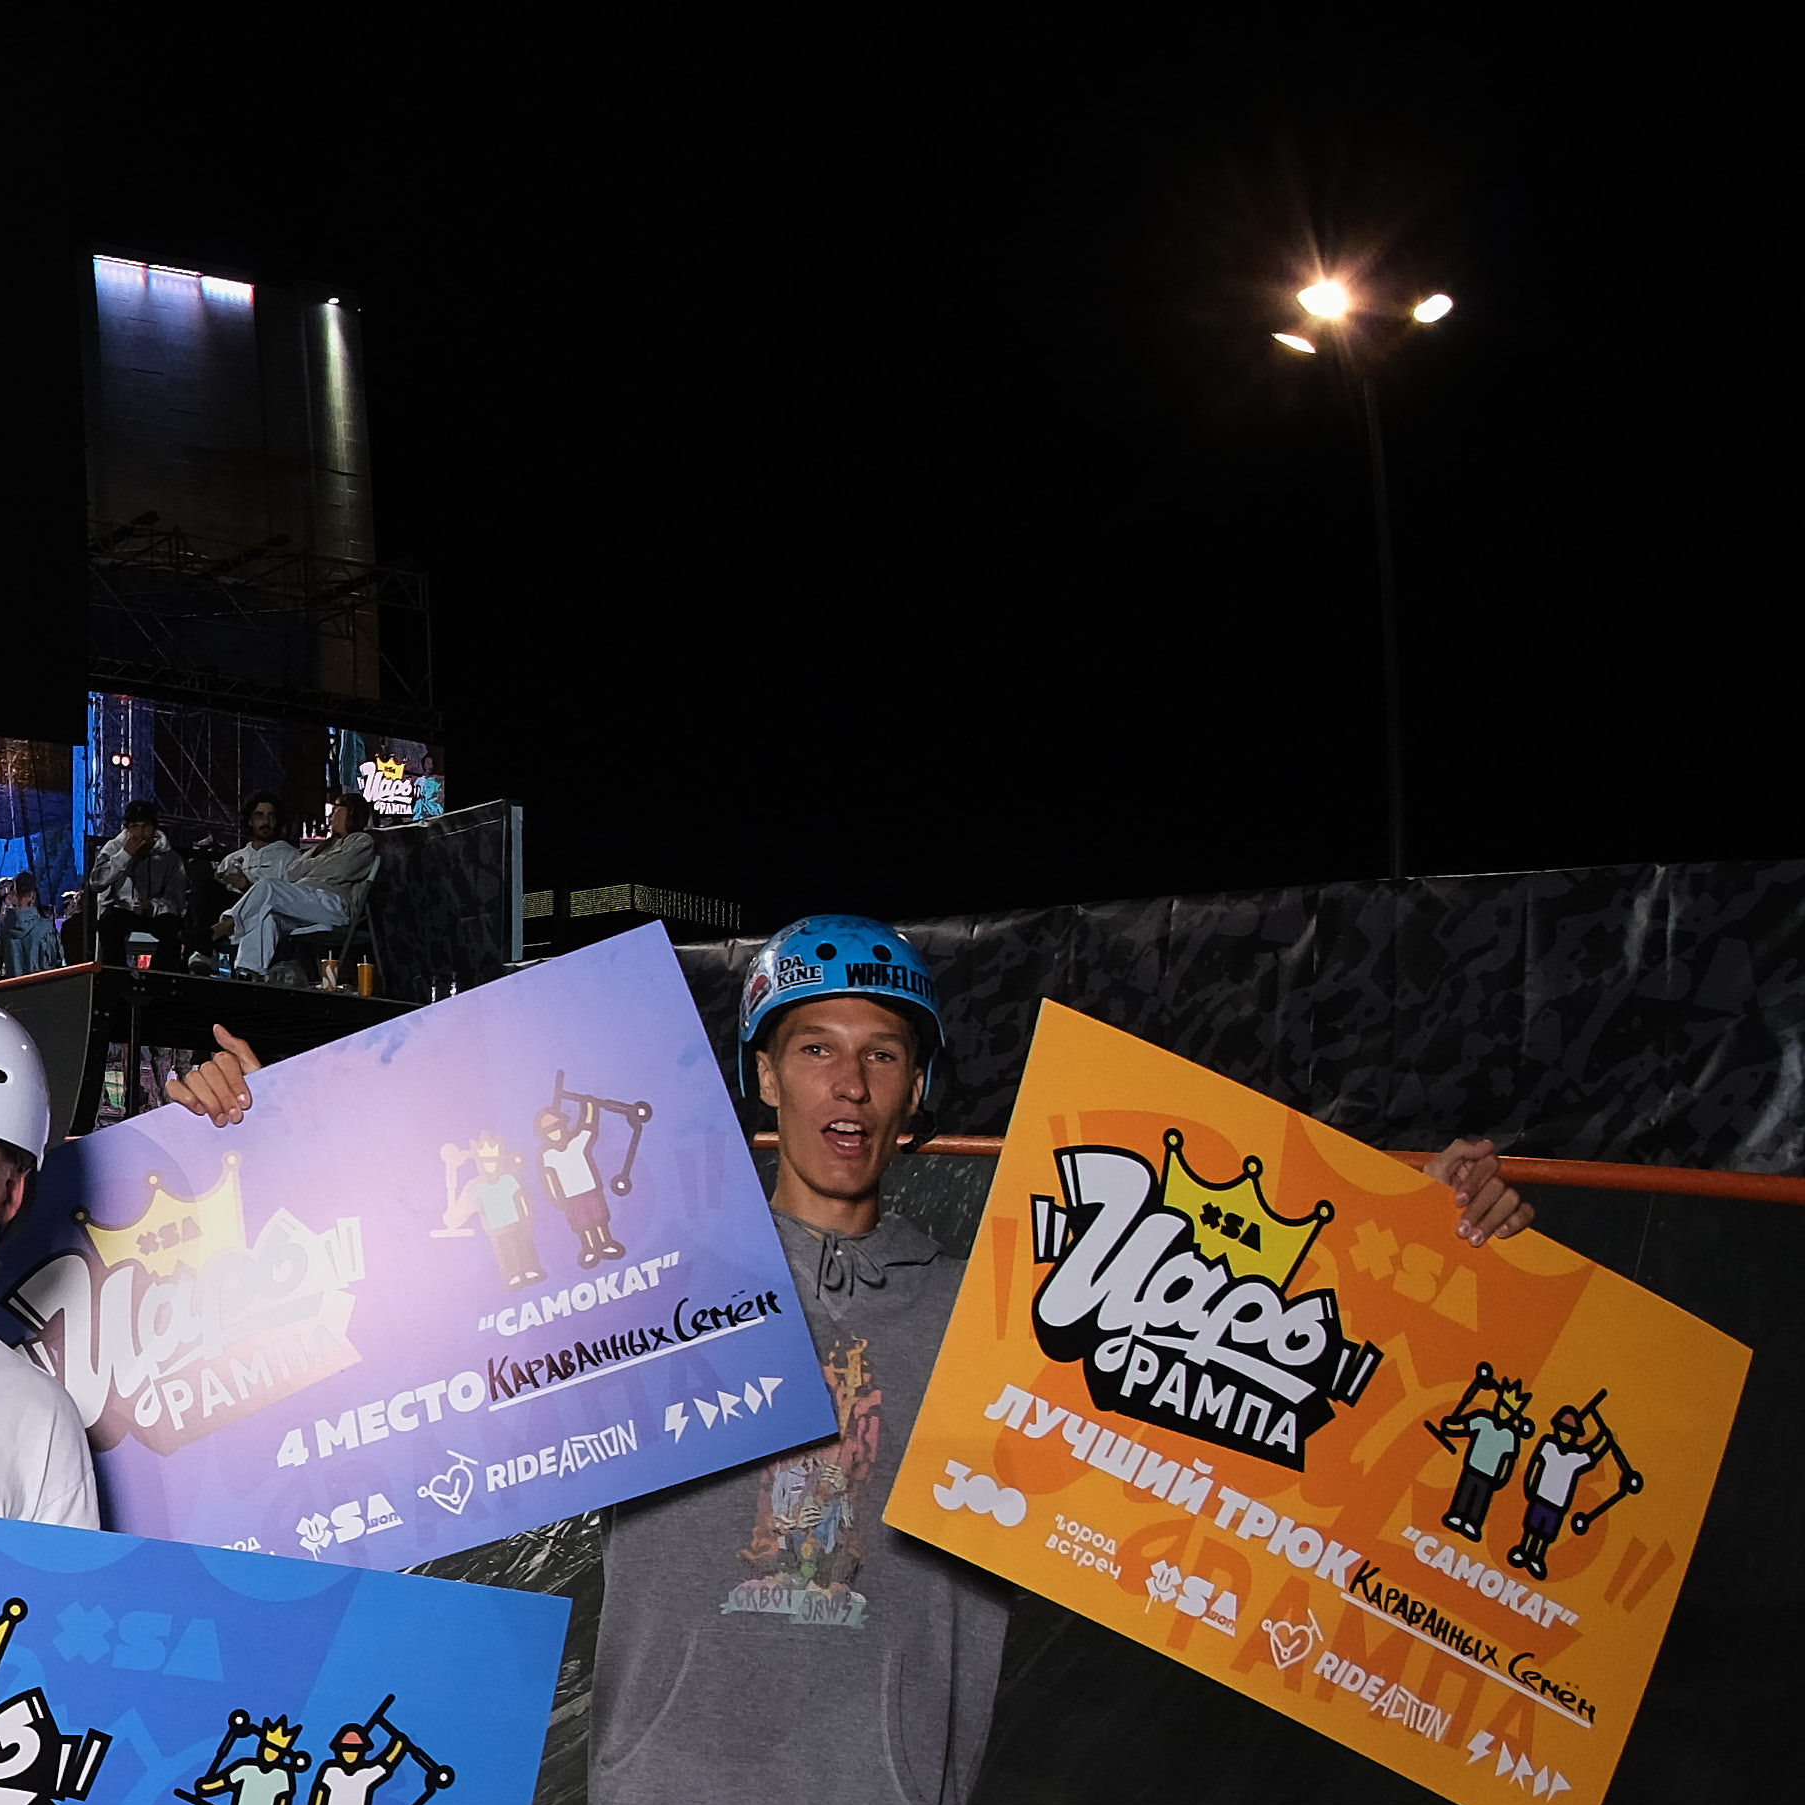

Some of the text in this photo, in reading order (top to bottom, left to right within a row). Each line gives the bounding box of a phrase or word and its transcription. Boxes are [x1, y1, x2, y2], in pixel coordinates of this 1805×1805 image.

[780, 955, 802, 972] DA
[276, 1376, 487, 1470] 4 МЕСТО
[1121, 1358, 1297, 1455] РАМПА
[985, 1386, 1357, 1590] ЛУЧШИЙ ТРЮК
